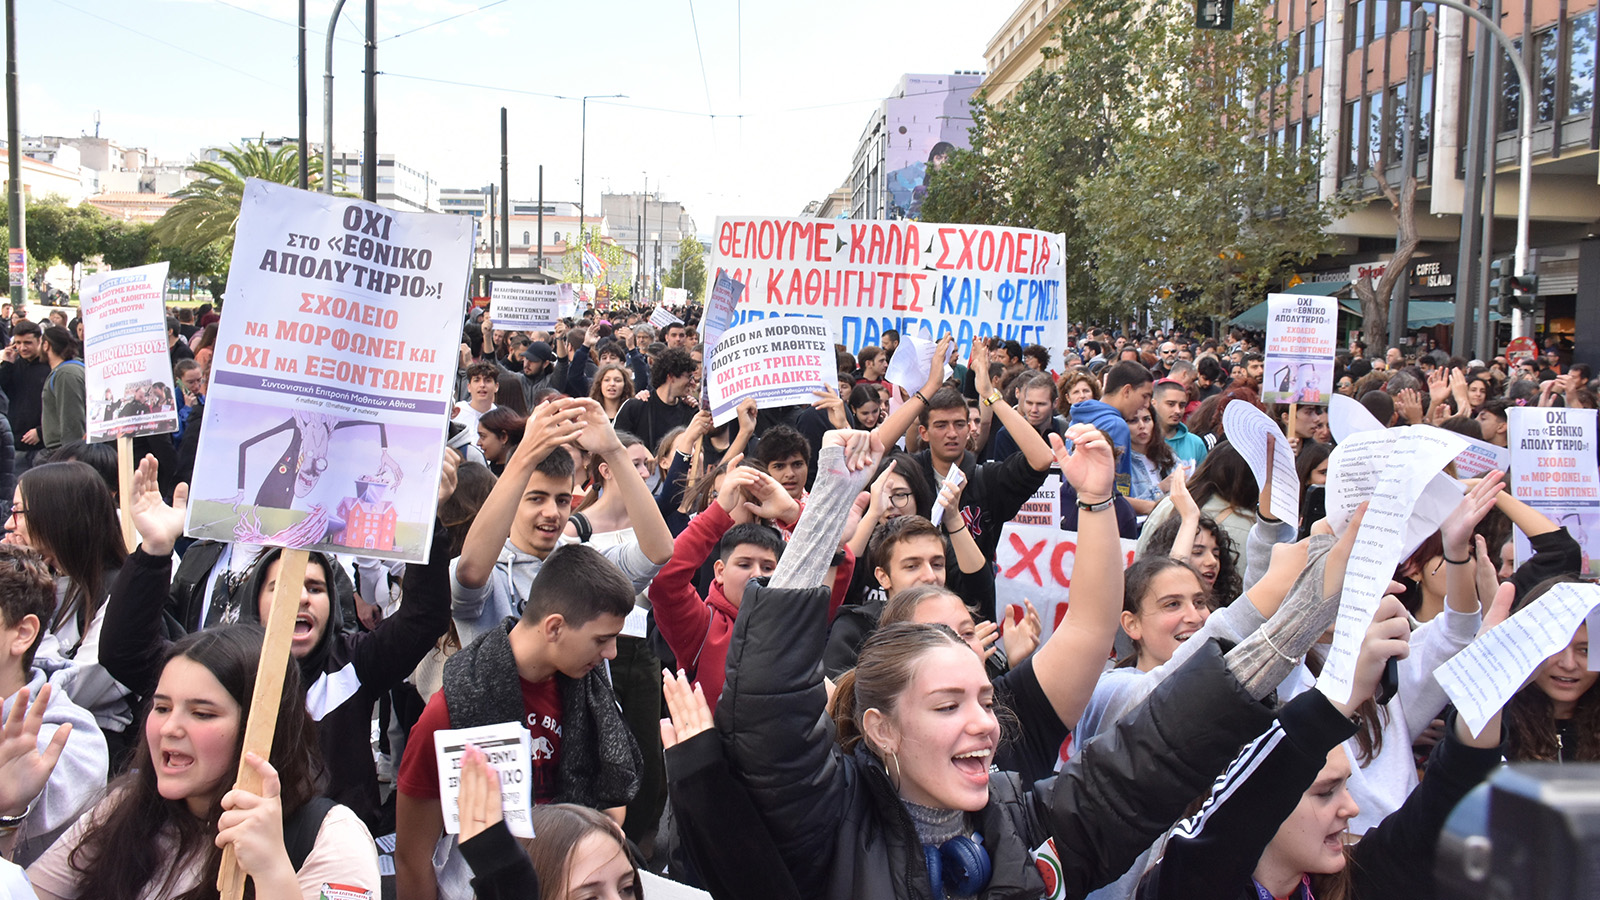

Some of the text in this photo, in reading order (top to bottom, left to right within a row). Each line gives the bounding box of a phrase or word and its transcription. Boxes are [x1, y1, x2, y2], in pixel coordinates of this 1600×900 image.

[342, 205, 393, 241] ΟΧΙ
[286, 232, 433, 271] ΣΤΟ «ΕΘΝΙΚΟ
[718, 219, 1051, 275] ΘΕΛΟΥΜΕ ΚΑΛΑ ΣΧΟΛΕΙΑ
[258, 248, 443, 300] ΑΠΟΛΥΤΗΡΙΟ»!
[1416, 262, 1440, 276] COFFEE
[1427, 274, 1452, 288] ISLAND
[120, 292, 161, 303] ΚΑΘΗΓΗΤΕΣ
[766, 267, 928, 313] ΚΑΘΗΓΗΤΕΣ
[939, 275, 981, 317] ΚΑΙ
[997, 278, 1060, 322] ΦΕΡΝΕΤΕ
[1297, 297, 1312, 306] ΟΧΙ
[298, 292, 399, 330] ΣΧΟΛΕΙΟ
[244, 319, 437, 363] ΝΑ ΜΟΡΦΩΝΕΙ ΚΑΙ
[709, 324, 827, 359] ΣΧΟΛΕΙΟ ΝΑ ΜΟΡΦΩΝΕΙ
[1280, 336, 1319, 344] ΜΟΡΦΩΝΕΙ
[1286, 326, 1316, 335] ΣΧΟΛΕΙΟ
[88, 339, 167, 368] ΒΓΑΙΝΟΥΜΕ ΣΤΟΥΣ
[711, 340, 826, 372] ΟΛΟΥΣ ΤΟΥΣ ΜΑΘΗΤΕΣ
[103, 358, 146, 379] ΔΡΟΜΟΥΣ
[225, 343, 445, 394] ΟΧΙ ΝΑ ΕΞΟΝΤΩΝΕΙ!
[716, 355, 822, 385] ΟΧΙ ΣΤΙΣ ΤΡΙΠΛΕΣ
[260, 378, 416, 410] Συντονιστική Επιτροπή Μαθητών Αθήνας
[720, 370, 822, 400] ΠΑΝΕΛΛΑΔΙΚΕΣ
[1528, 425, 1583, 437] ΣΤΟ «ΕΘΝΙΚΟ
[1546, 411, 1567, 424] ΟΧΙ
[1520, 474, 1530, 482] ΝΑ
[1531, 471, 1581, 482] ΜΟΡΦΩΝΕΙ
[1537, 457, 1577, 468] ΣΧΟΛΕΙΟ
[1516, 486, 1597, 497] ΟΧΙ ΝΑ ΕΞΟΝΤΩΝΕΙ!
[1017, 514, 1051, 525] ΧΑΡΤΙΑ!
